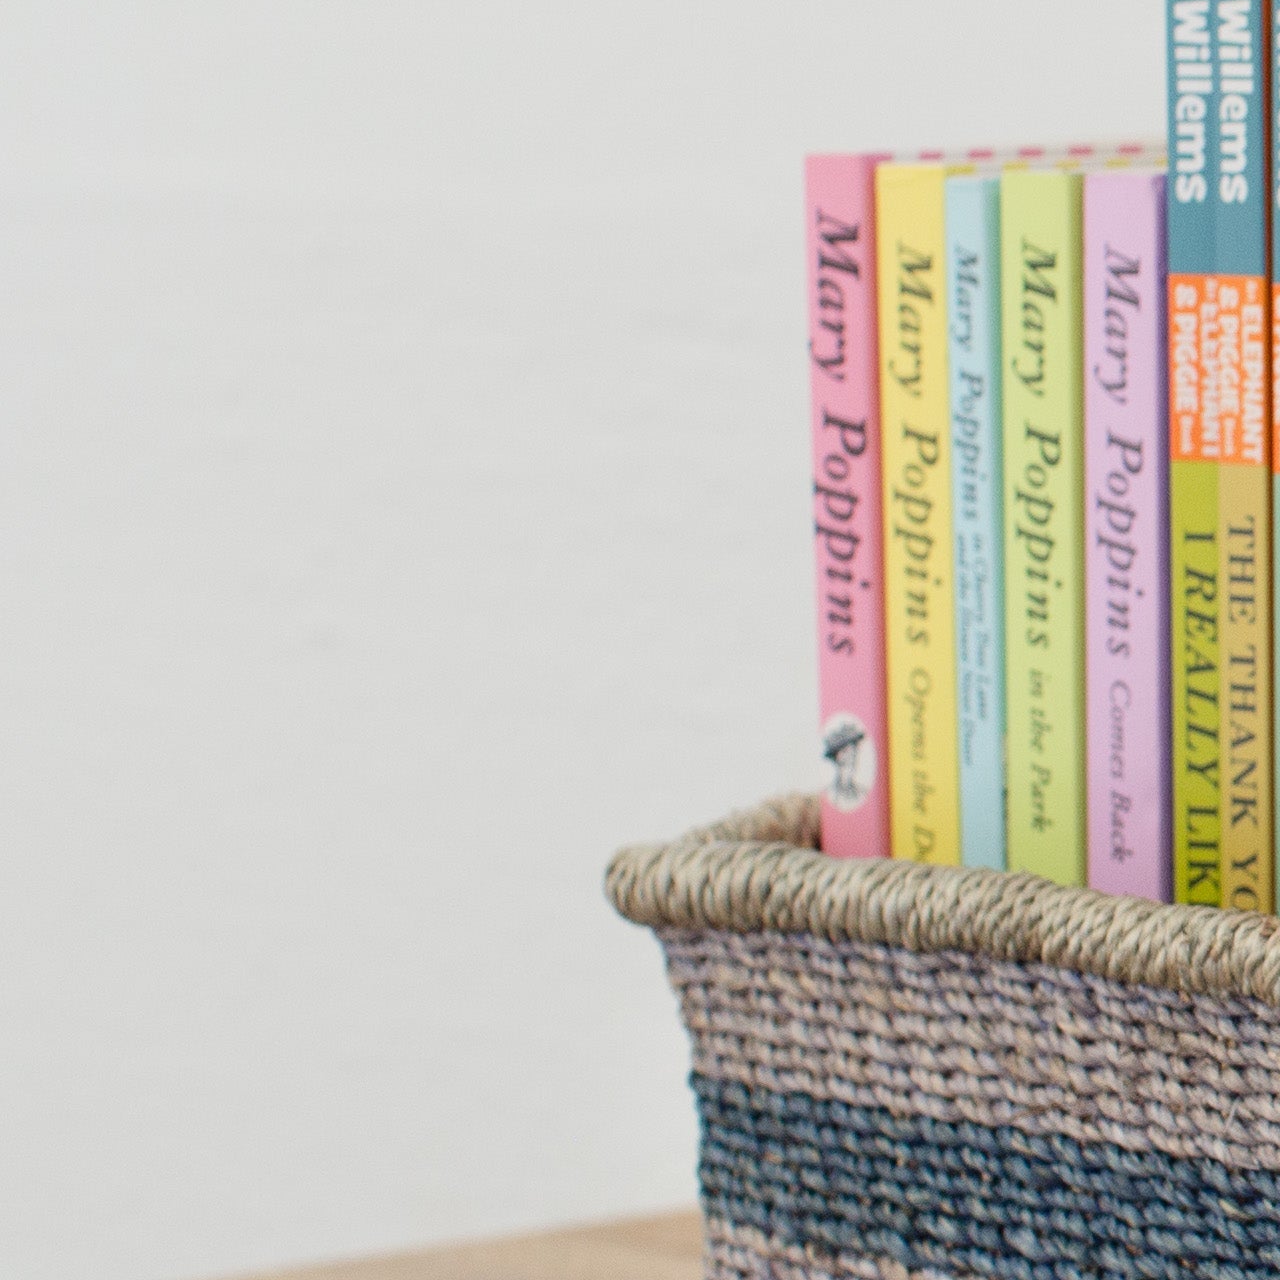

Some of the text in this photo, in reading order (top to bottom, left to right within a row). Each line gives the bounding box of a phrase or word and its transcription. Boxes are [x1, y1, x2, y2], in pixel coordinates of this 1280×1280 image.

[889, 242, 935, 399] Mary
[950, 243, 980, 353] Mary
[1012, 236, 1059, 399] Mary
[808, 209, 870, 657] Mary Poppins
[953, 367, 987, 520] Poppins
[892, 422, 944, 648] Poppins
[1015, 422, 1064, 651] Poppins
[1094, 243, 1145, 866] Mary Poppins Comes Back
[1184, 530, 1215, 543] I
[1227, 516, 1256, 625] THE
[1029, 706, 1050, 754] the
[1184, 568, 1220, 787] REALLY
[1229, 645, 1259, 828] THANK
[1031, 763, 1050, 834] Park
